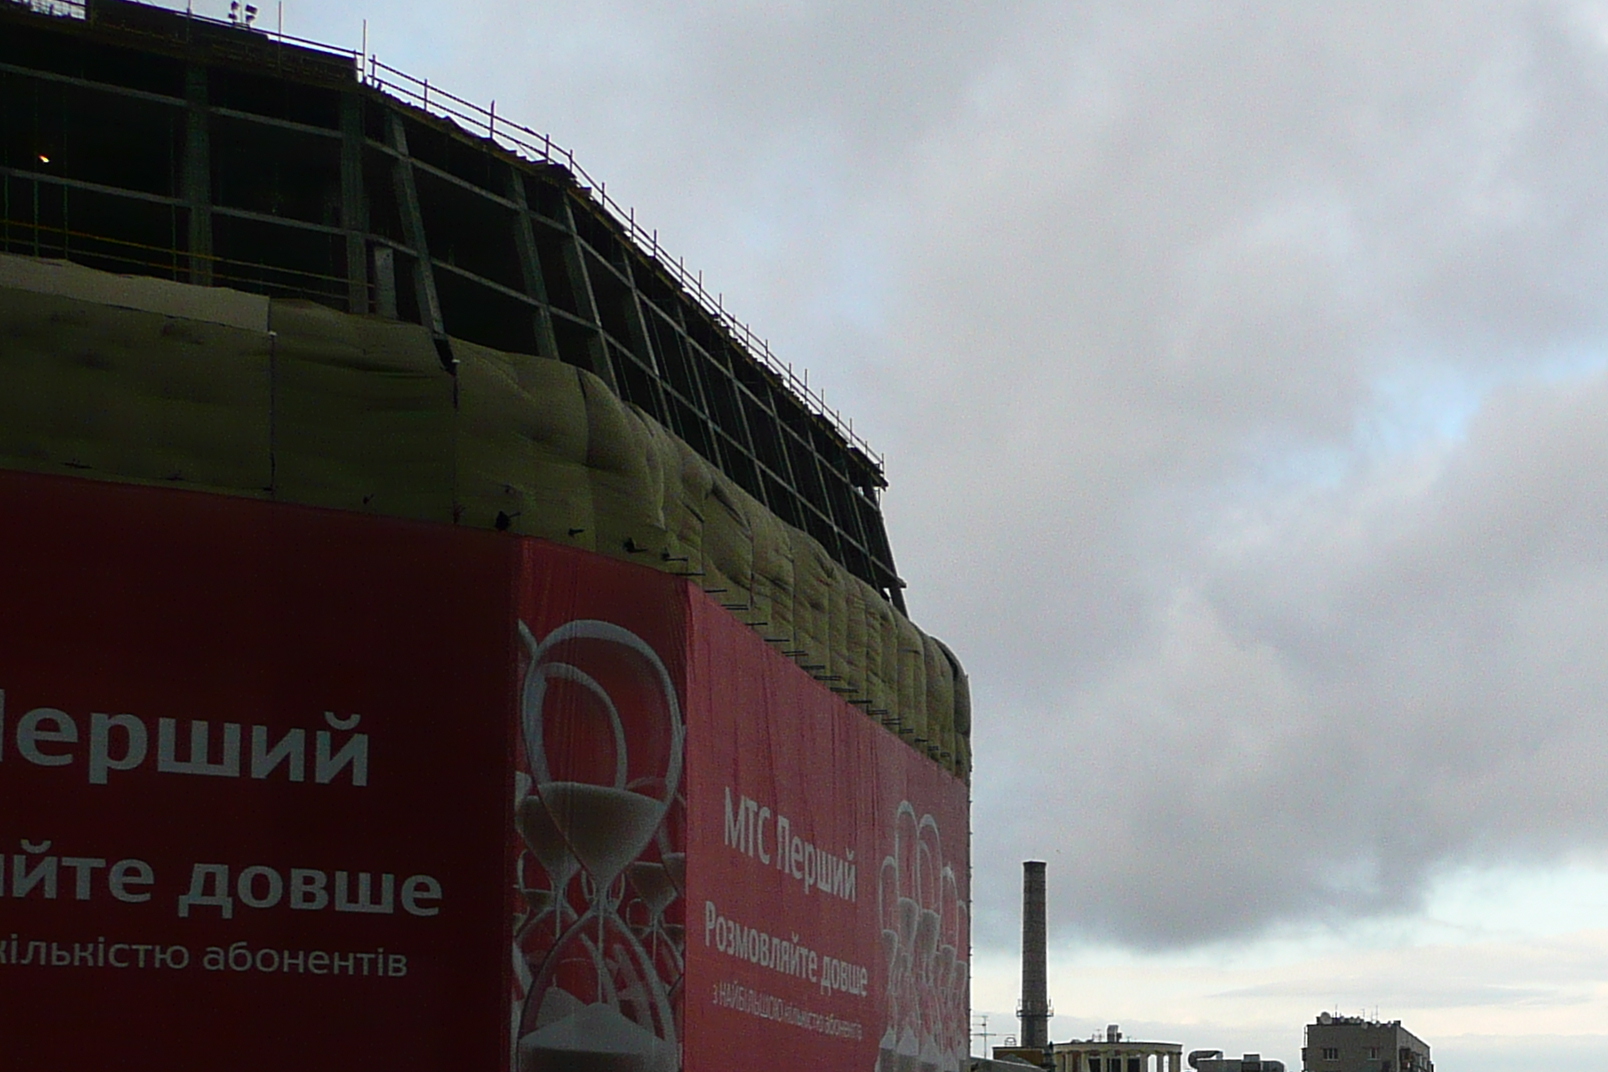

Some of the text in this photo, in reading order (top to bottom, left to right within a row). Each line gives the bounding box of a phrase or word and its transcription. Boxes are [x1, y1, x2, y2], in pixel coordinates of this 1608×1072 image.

[0, 688, 368, 786] ерший
[0, 838, 444, 920] йте довше
[723, 786, 858, 903] МТС Перший
[203, 941, 409, 978] абонентів
[705, 900, 868, 997] Розмовляйте довше
